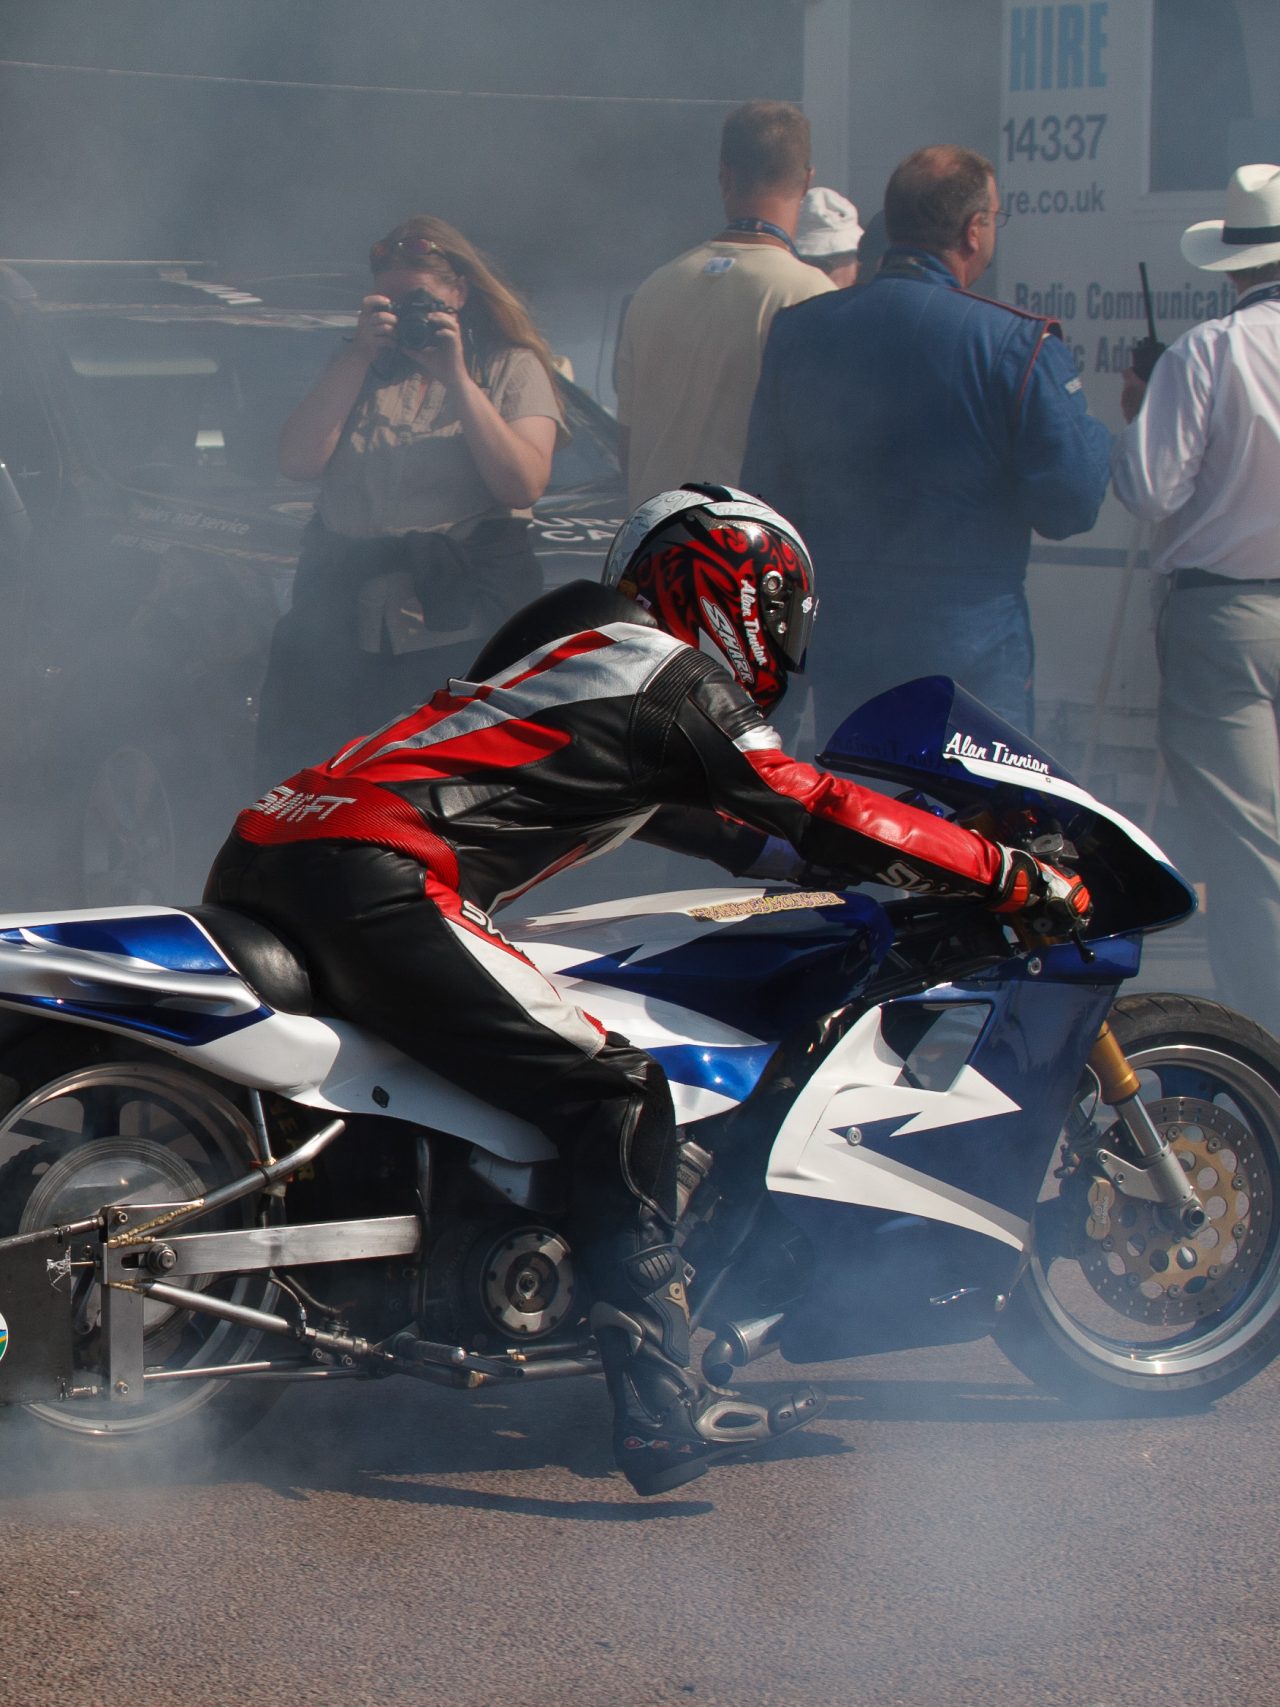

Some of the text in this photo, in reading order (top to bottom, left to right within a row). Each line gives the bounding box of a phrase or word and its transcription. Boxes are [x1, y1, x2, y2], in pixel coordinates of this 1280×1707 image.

[1009, 2, 1108, 91] HIRE
[1015, 282, 1077, 320] Radio
[199, 517, 250, 536] service
[740, 578, 757, 617] Alan
[699, 596, 755, 684] SHARK
[945, 731, 987, 760] Alan
[991, 741, 1049, 775] Tinnion
